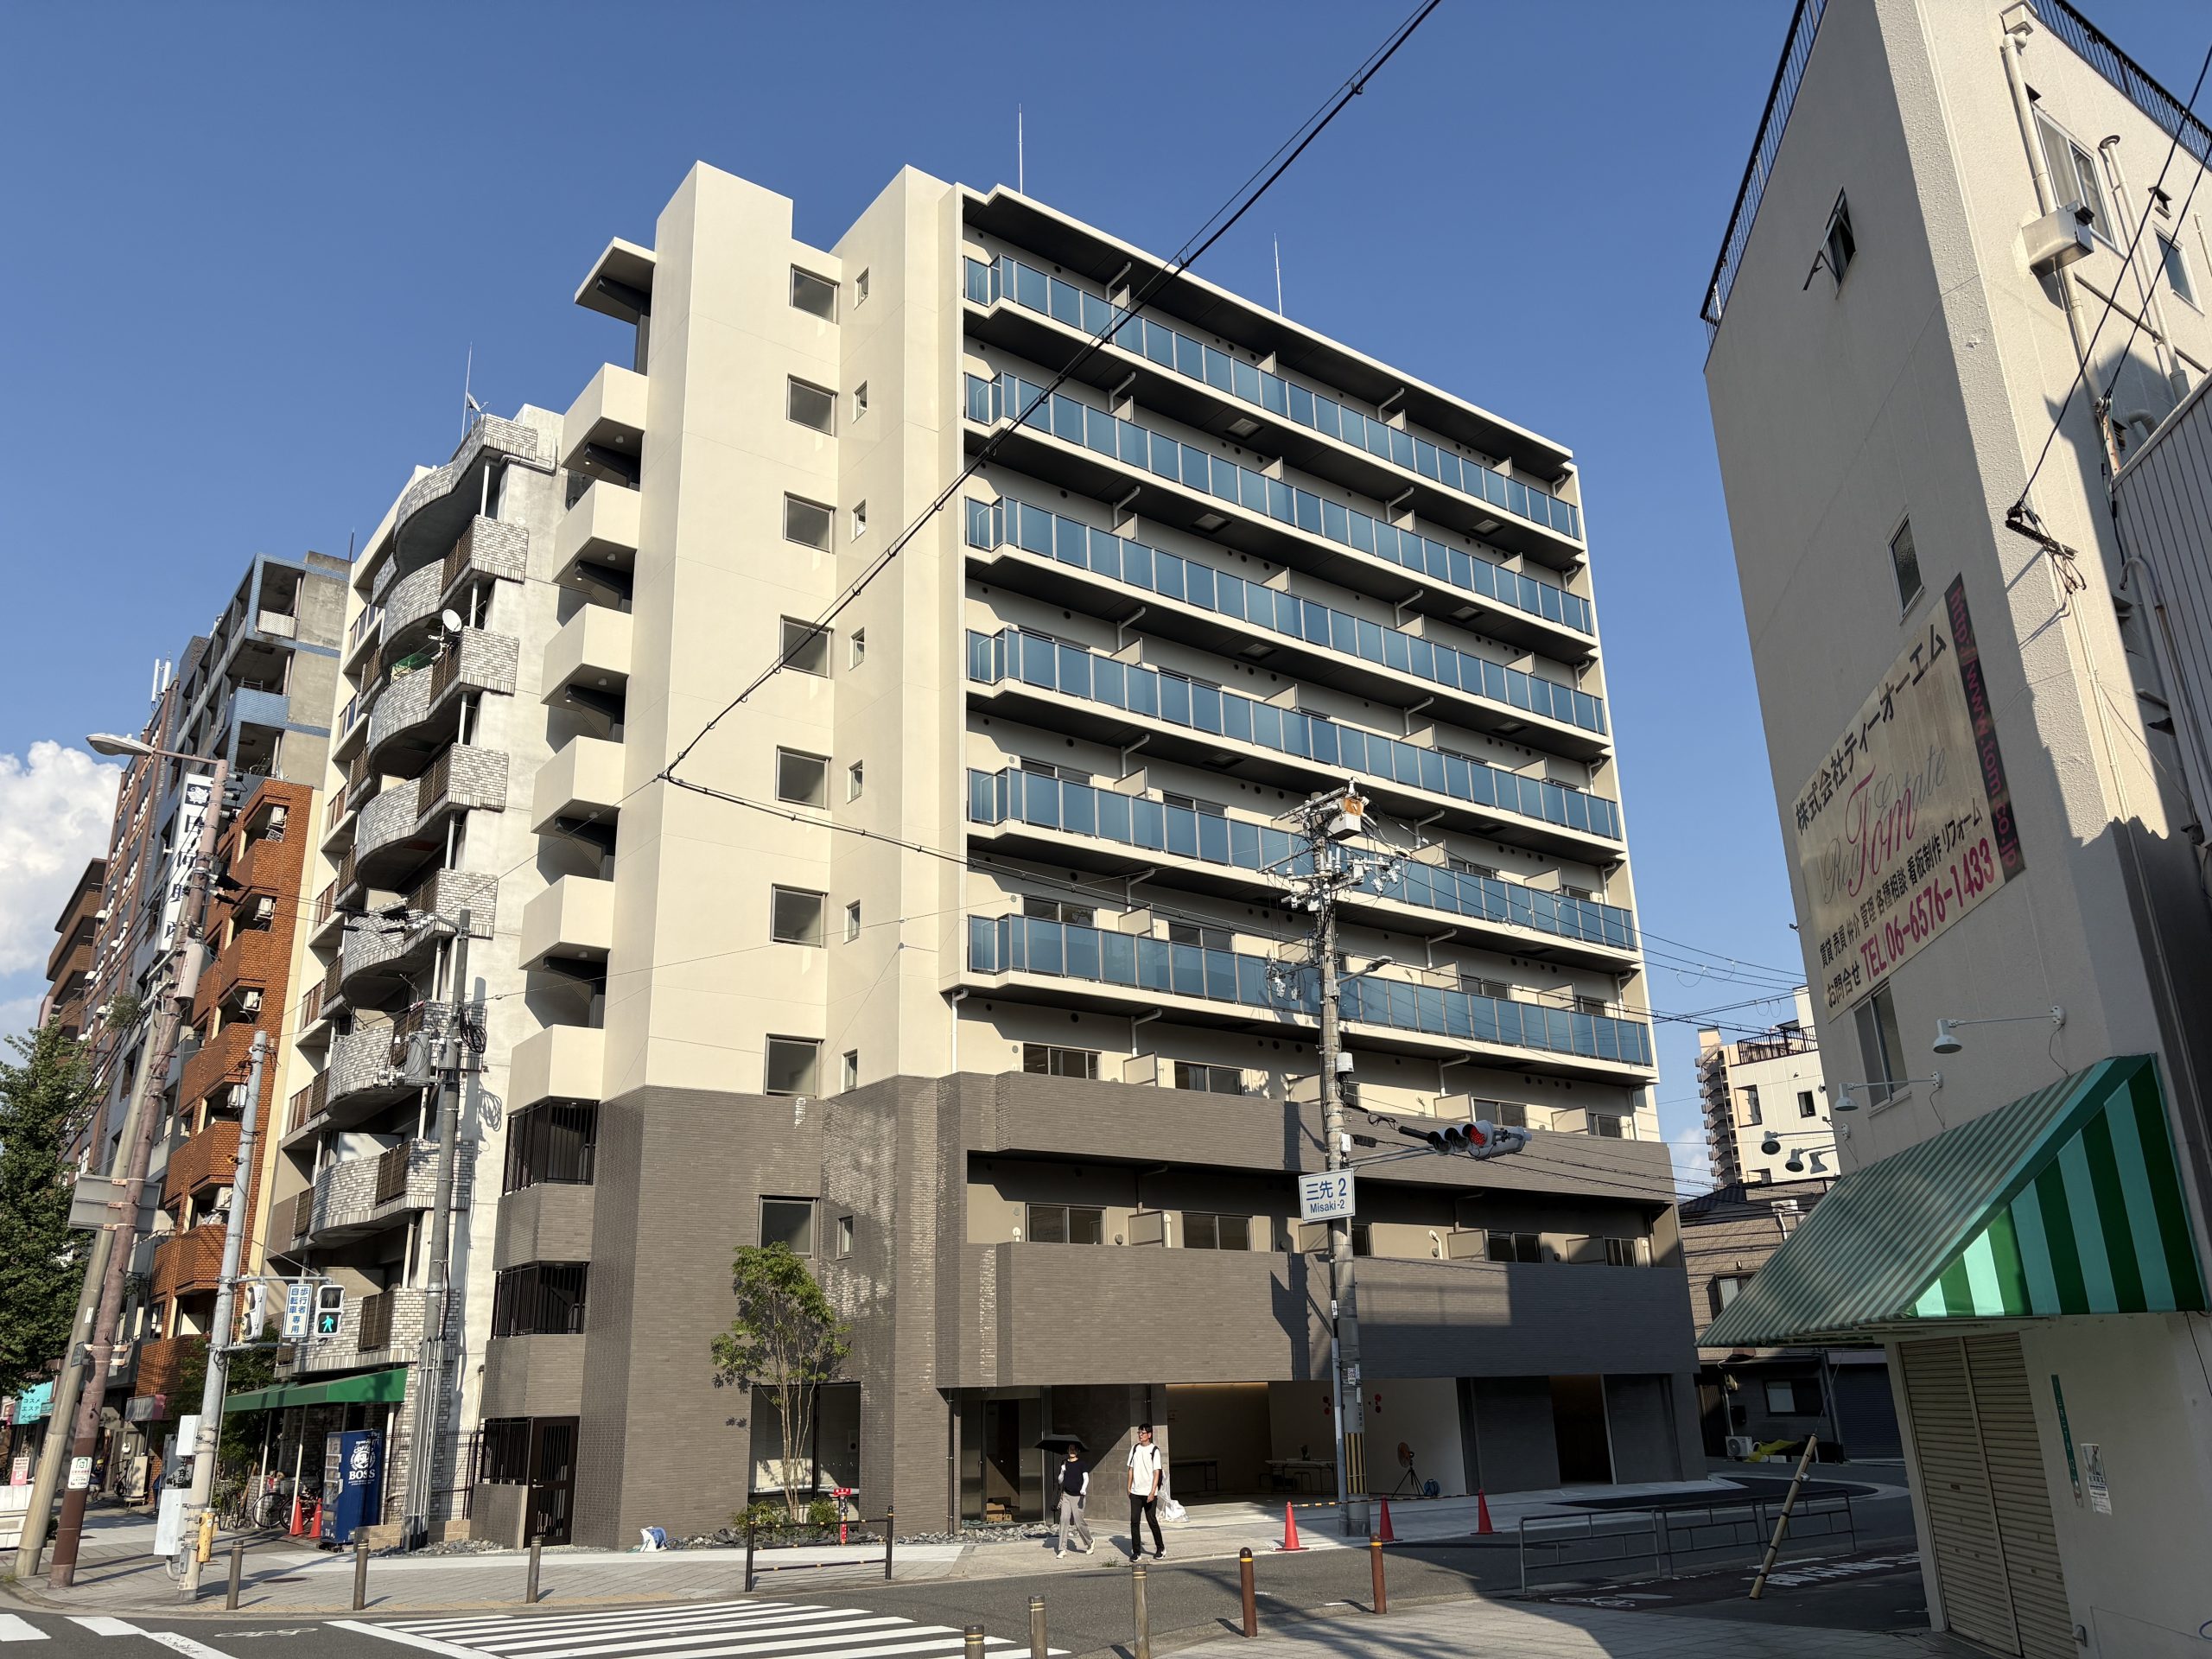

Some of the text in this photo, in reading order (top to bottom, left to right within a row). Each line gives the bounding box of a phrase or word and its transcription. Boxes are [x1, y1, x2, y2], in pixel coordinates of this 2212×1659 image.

[1796, 624, 1947, 836] 株式会社ティーオーエム
[1846, 765, 1918, 898] Tom
[1876, 869, 1908, 917] 各種相談
[1907, 836, 1942, 888] 看板制作
[1942, 798, 1983, 854] リフォーム
[1827, 837, 1995, 1007] お問合せ TEL 06-6576-1433
[1306, 1178, 1347, 1201] 三先 2
[1310, 1199, 1345, 1214] Misaki-2
[289, 1287, 300, 1314] 自転車
[298, 1287, 309, 1314] 歩行者
[290, 1315, 301, 1333] 専用
[348, 1468, 376, 1481] BOSS
